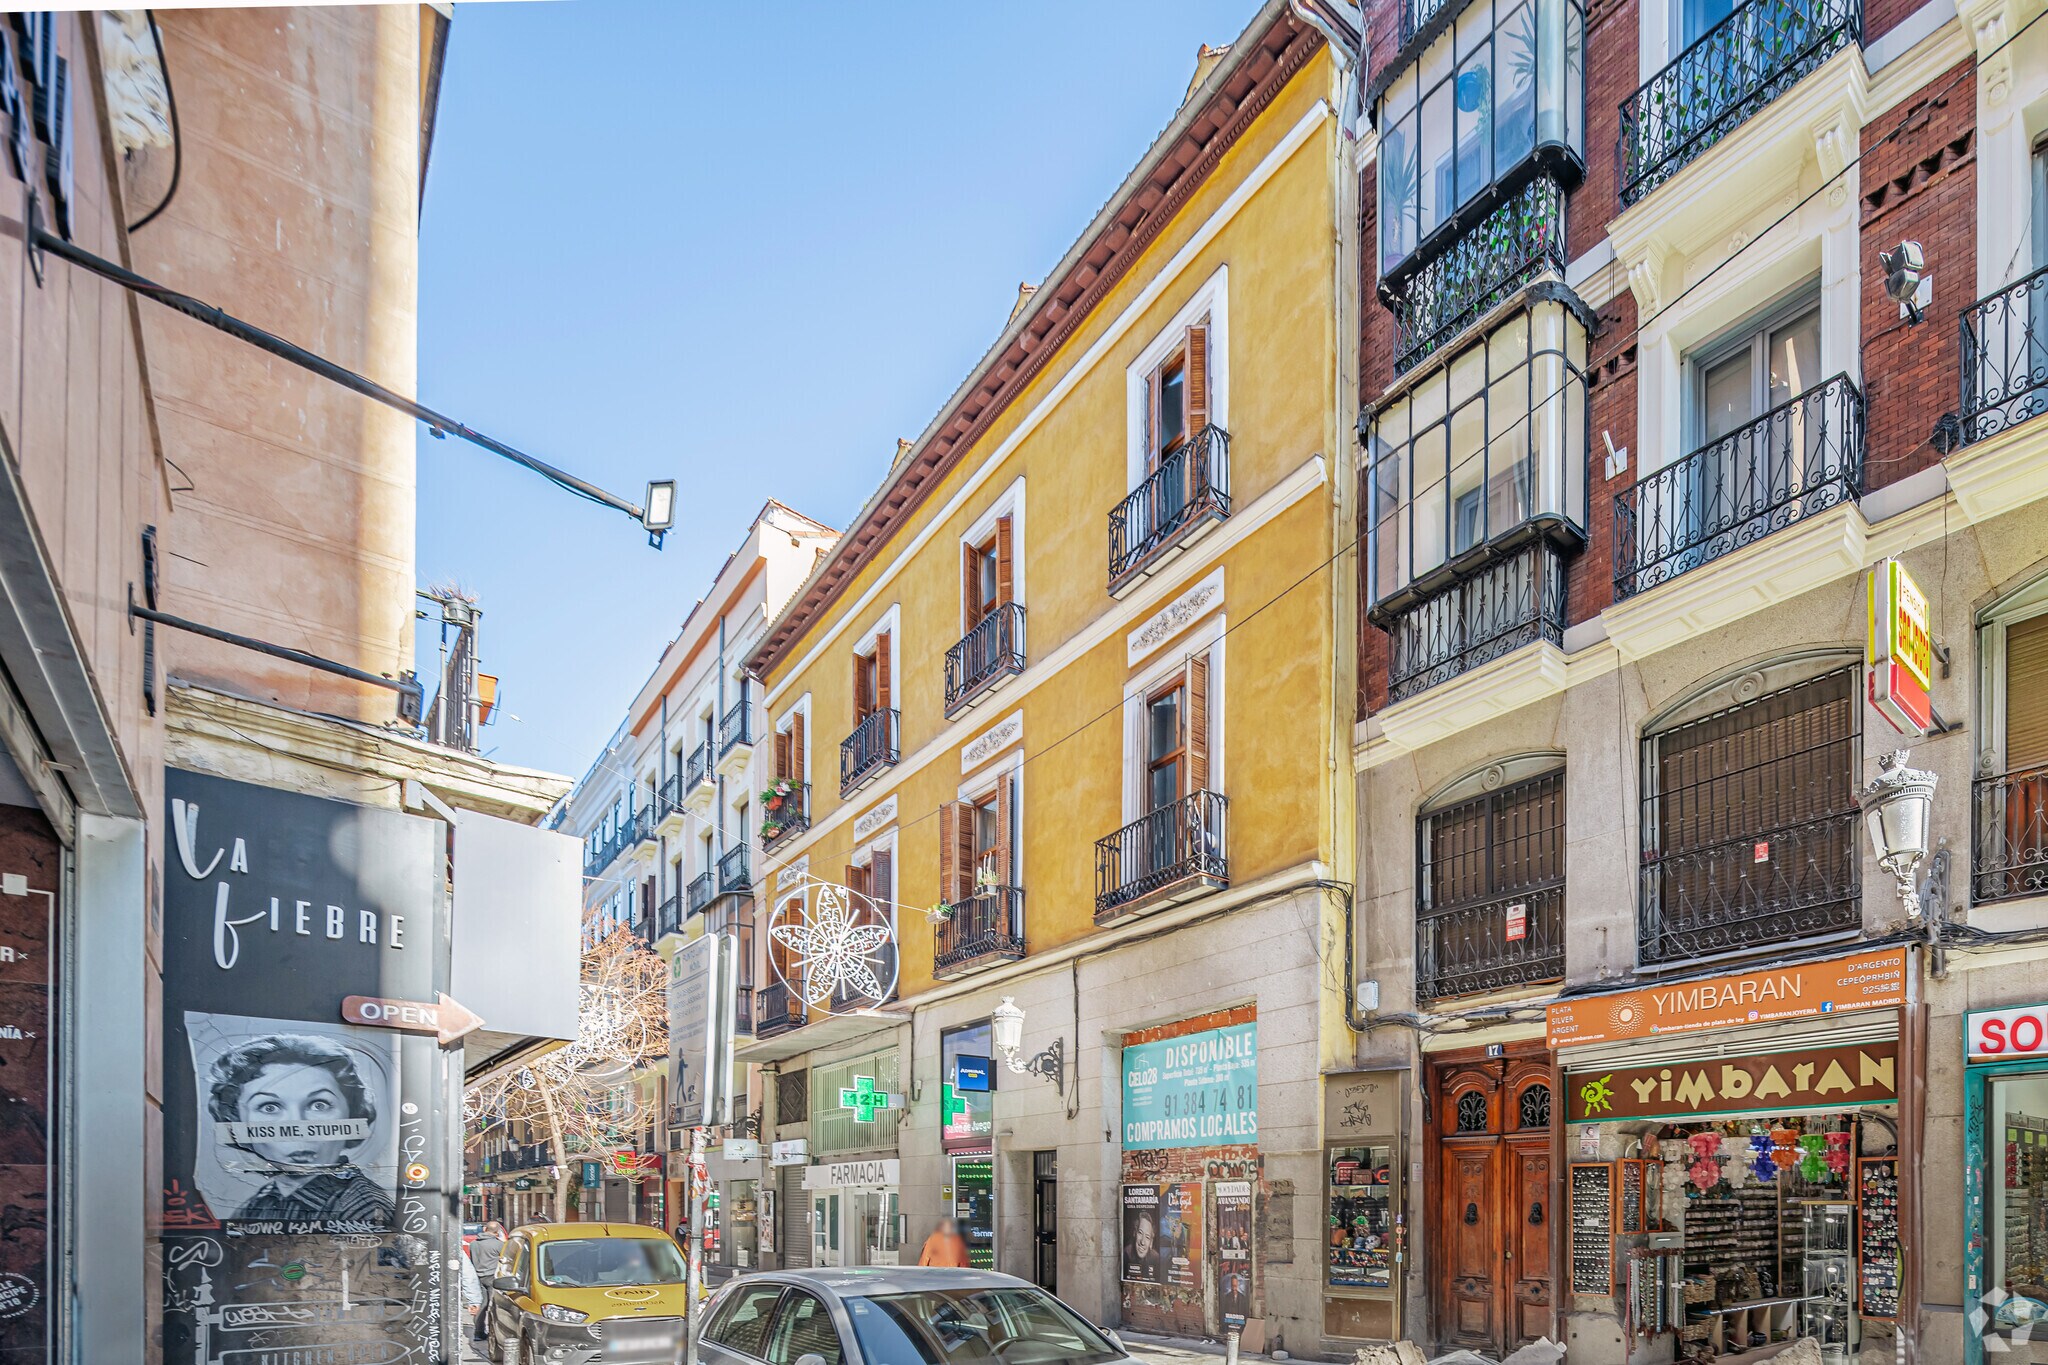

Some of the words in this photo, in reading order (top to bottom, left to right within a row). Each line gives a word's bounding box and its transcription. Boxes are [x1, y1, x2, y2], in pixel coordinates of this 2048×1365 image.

[1848, 957, 1900, 973] D'ARGENTO
[1652, 973, 1801, 1017] YIMBARAN
[1551, 1006, 1572, 1015] PLATA
[1835, 1001, 1871, 1011] YIMBARAN
[1872, 997, 1901, 1008] MADRID
[359, 1002, 438, 1027] OPEN
[1551, 1015, 1574, 1025] SILVER
[1759, 1007, 1817, 1020] YIMBARANJOYERIA
[1703, 1020, 1711, 1028] de
[1711, 1018, 1726, 1028] plata
[1727, 1017, 1735, 1025] de
[1735, 1016, 1745, 1026] ley
[1551, 1024, 1579, 1035] ARGENT
[1979, 1015, 2048, 1054] SO
[1165, 1032, 1253, 1069] DISPONIBLE
[1488, 1044, 1500, 1057] 17
[1128, 1067, 1158, 1088] CIELO28
[1164, 1093, 1178, 1117] 91
[1183, 1089, 1206, 1116] 384
[1213, 1087, 1227, 1113] 74
[1237, 1083, 1253, 1110] 81
[246, 1126, 276, 1138] KISS
[307, 1124, 352, 1137] STUPID
[1127, 1116, 1197, 1143] COMPRAMOS
[1201, 1110, 1257, 1138] LOCALES
[830, 1161, 886, 1185] FARMACIA
[1128, 1187, 1154, 1196] LORENZO
[1124, 1193, 1159, 1205] SANTAMARÍA
